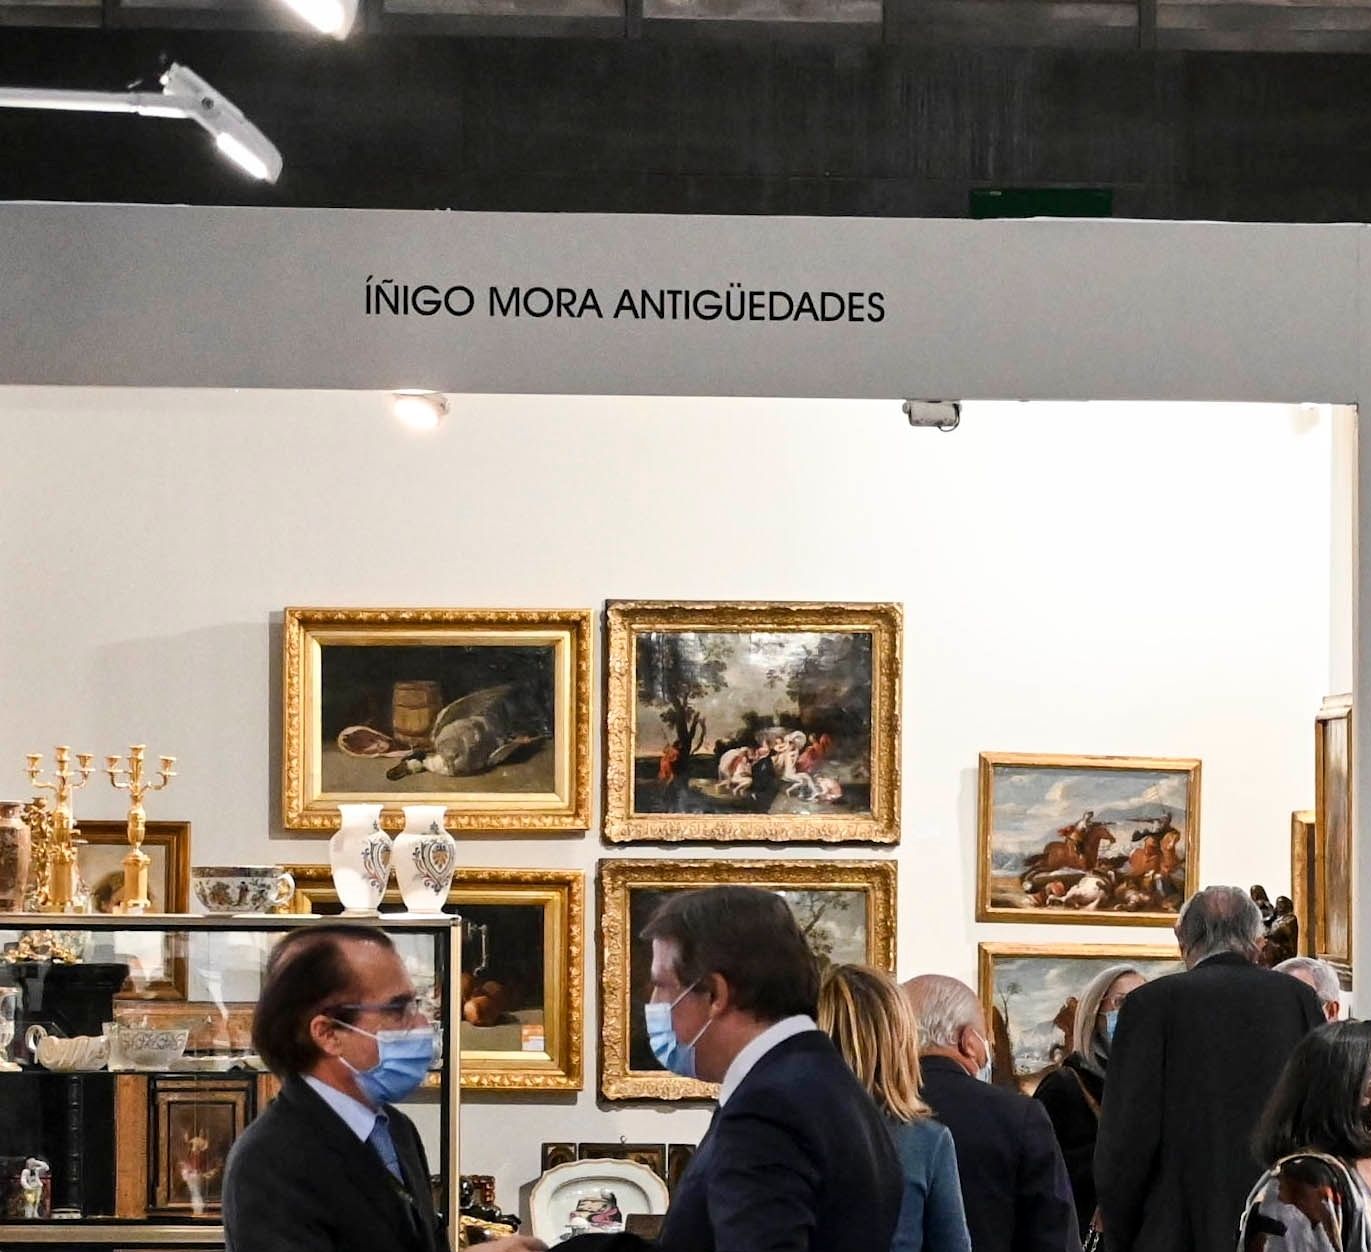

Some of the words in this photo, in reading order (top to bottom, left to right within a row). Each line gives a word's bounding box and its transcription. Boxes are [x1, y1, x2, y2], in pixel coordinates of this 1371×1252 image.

[365, 275, 474, 317] ÍÑIGO
[489, 286, 604, 319] MORA
[612, 282, 886, 323] ANTIGÜEDADES
